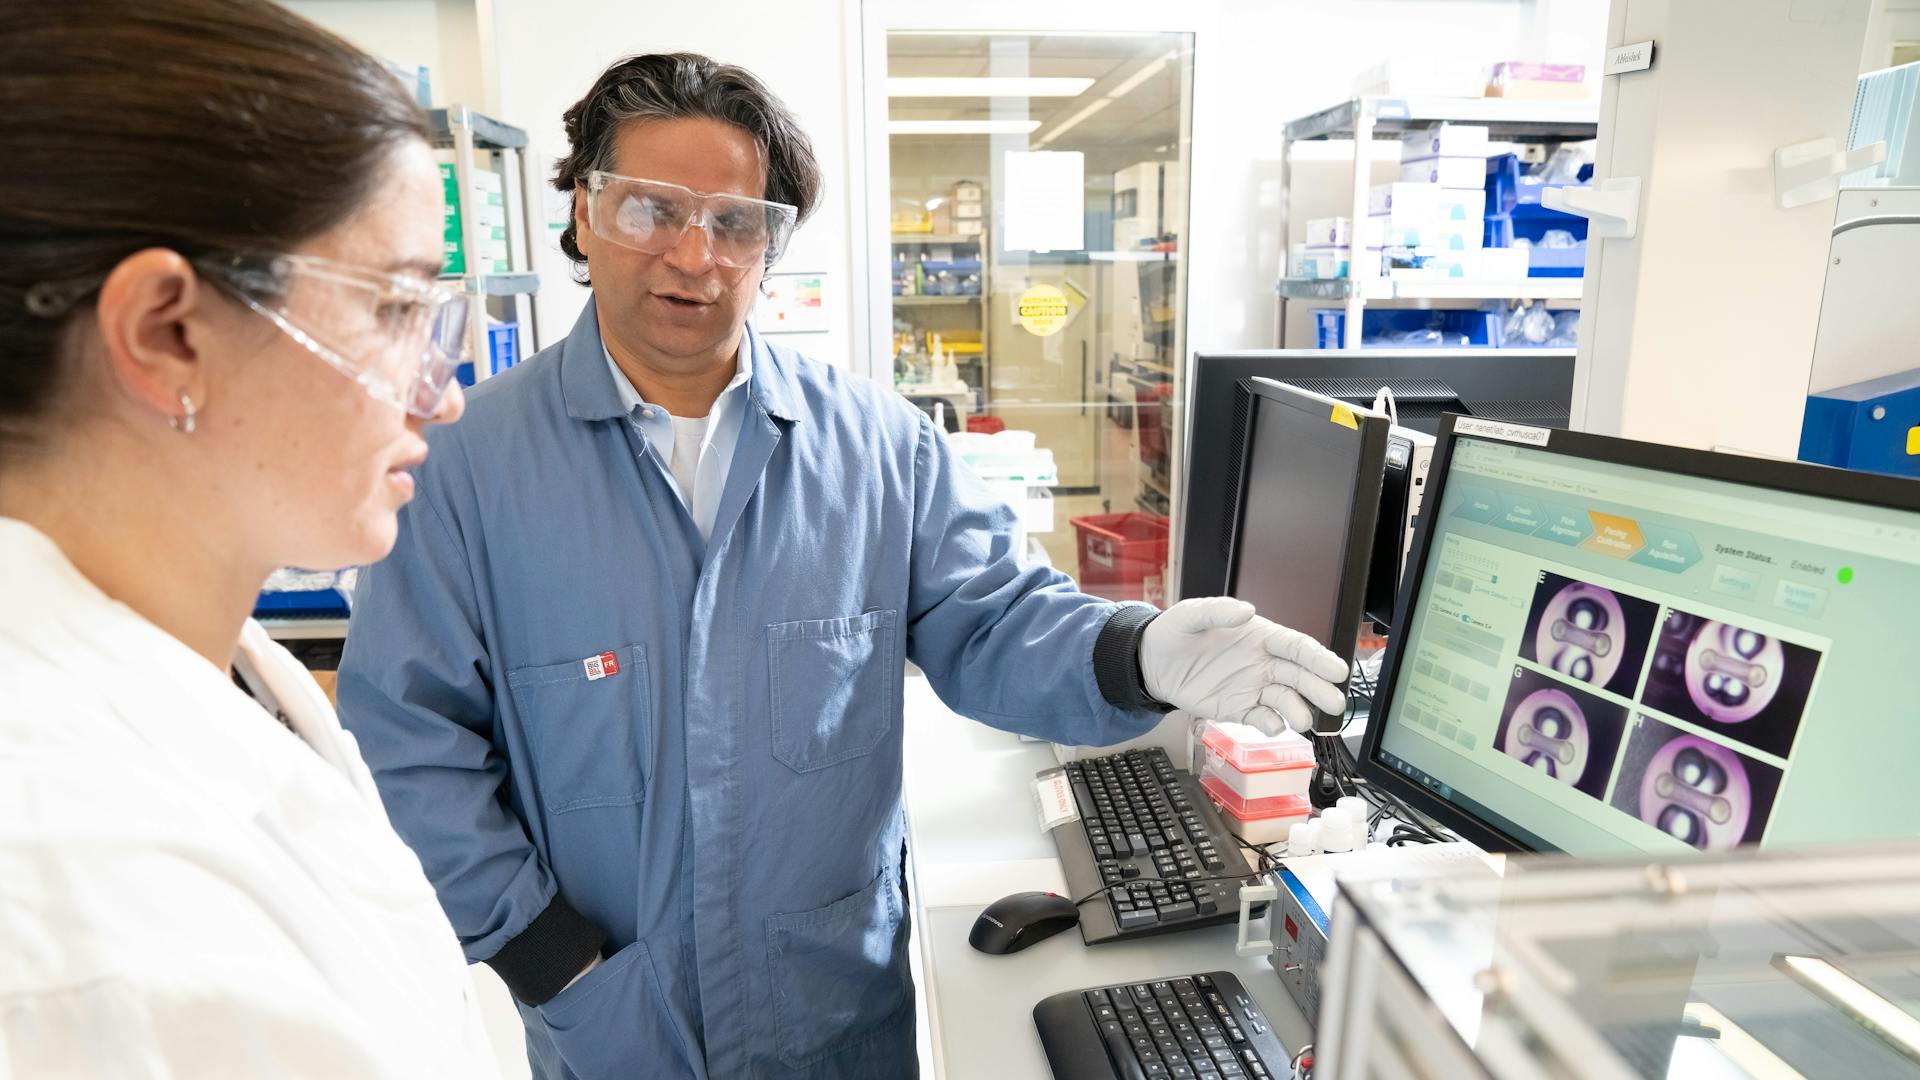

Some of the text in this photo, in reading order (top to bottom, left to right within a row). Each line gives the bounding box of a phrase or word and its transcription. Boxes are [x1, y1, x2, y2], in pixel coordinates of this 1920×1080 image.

[1020, 306, 1066, 316] CAUTION
[1714, 543, 1744, 558] System
[1790, 559, 1826, 575] Enabled
[1538, 571, 1546, 584] E
[1664, 609, 1674, 622] F
[1514, 667, 1522, 678] G
[1634, 714, 1645, 728] H
